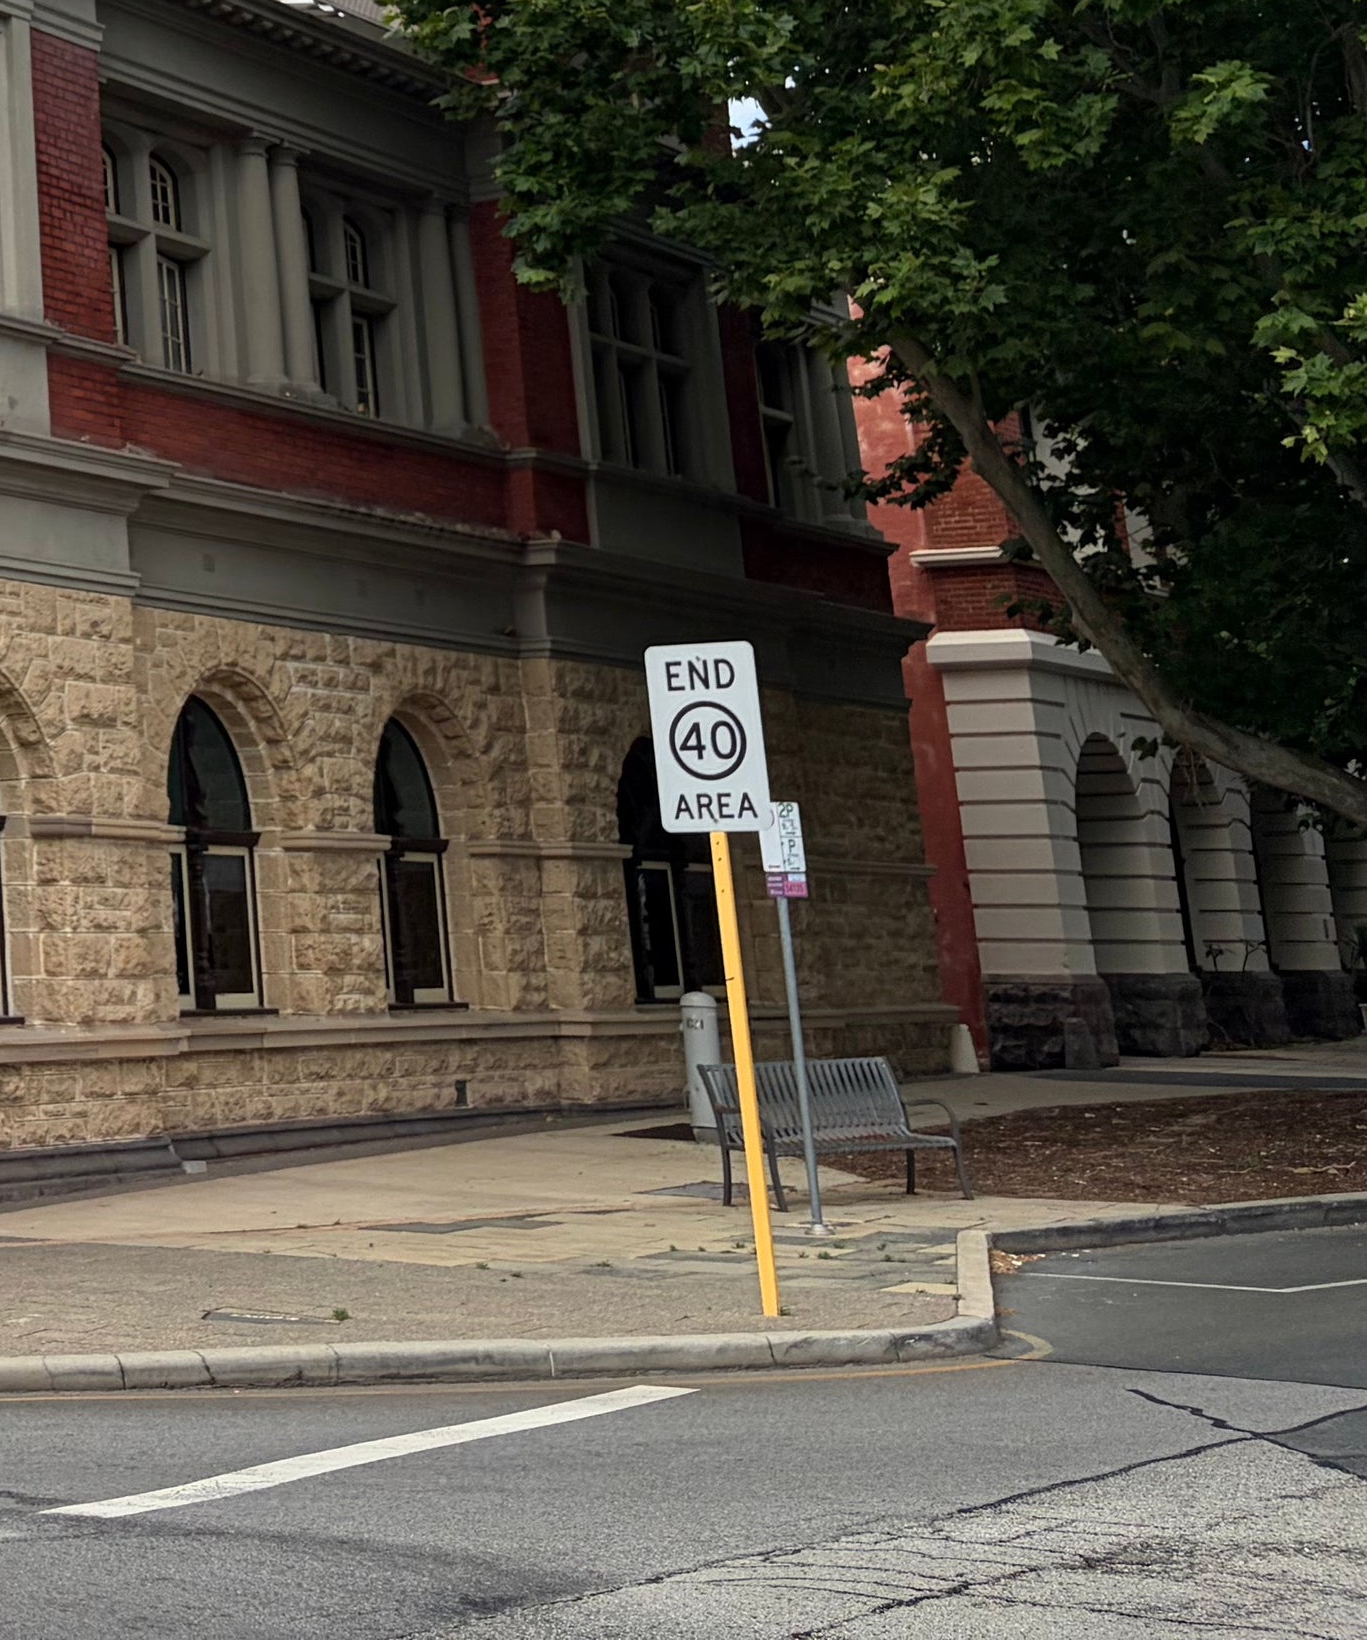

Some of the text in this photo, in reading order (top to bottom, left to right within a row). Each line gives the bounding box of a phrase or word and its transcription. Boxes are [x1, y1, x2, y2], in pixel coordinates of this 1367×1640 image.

[665, 658, 735, 691] END
[679, 720, 738, 761] 40
[674, 792, 758, 820] AREA
[778, 802, 794, 818] 2P
